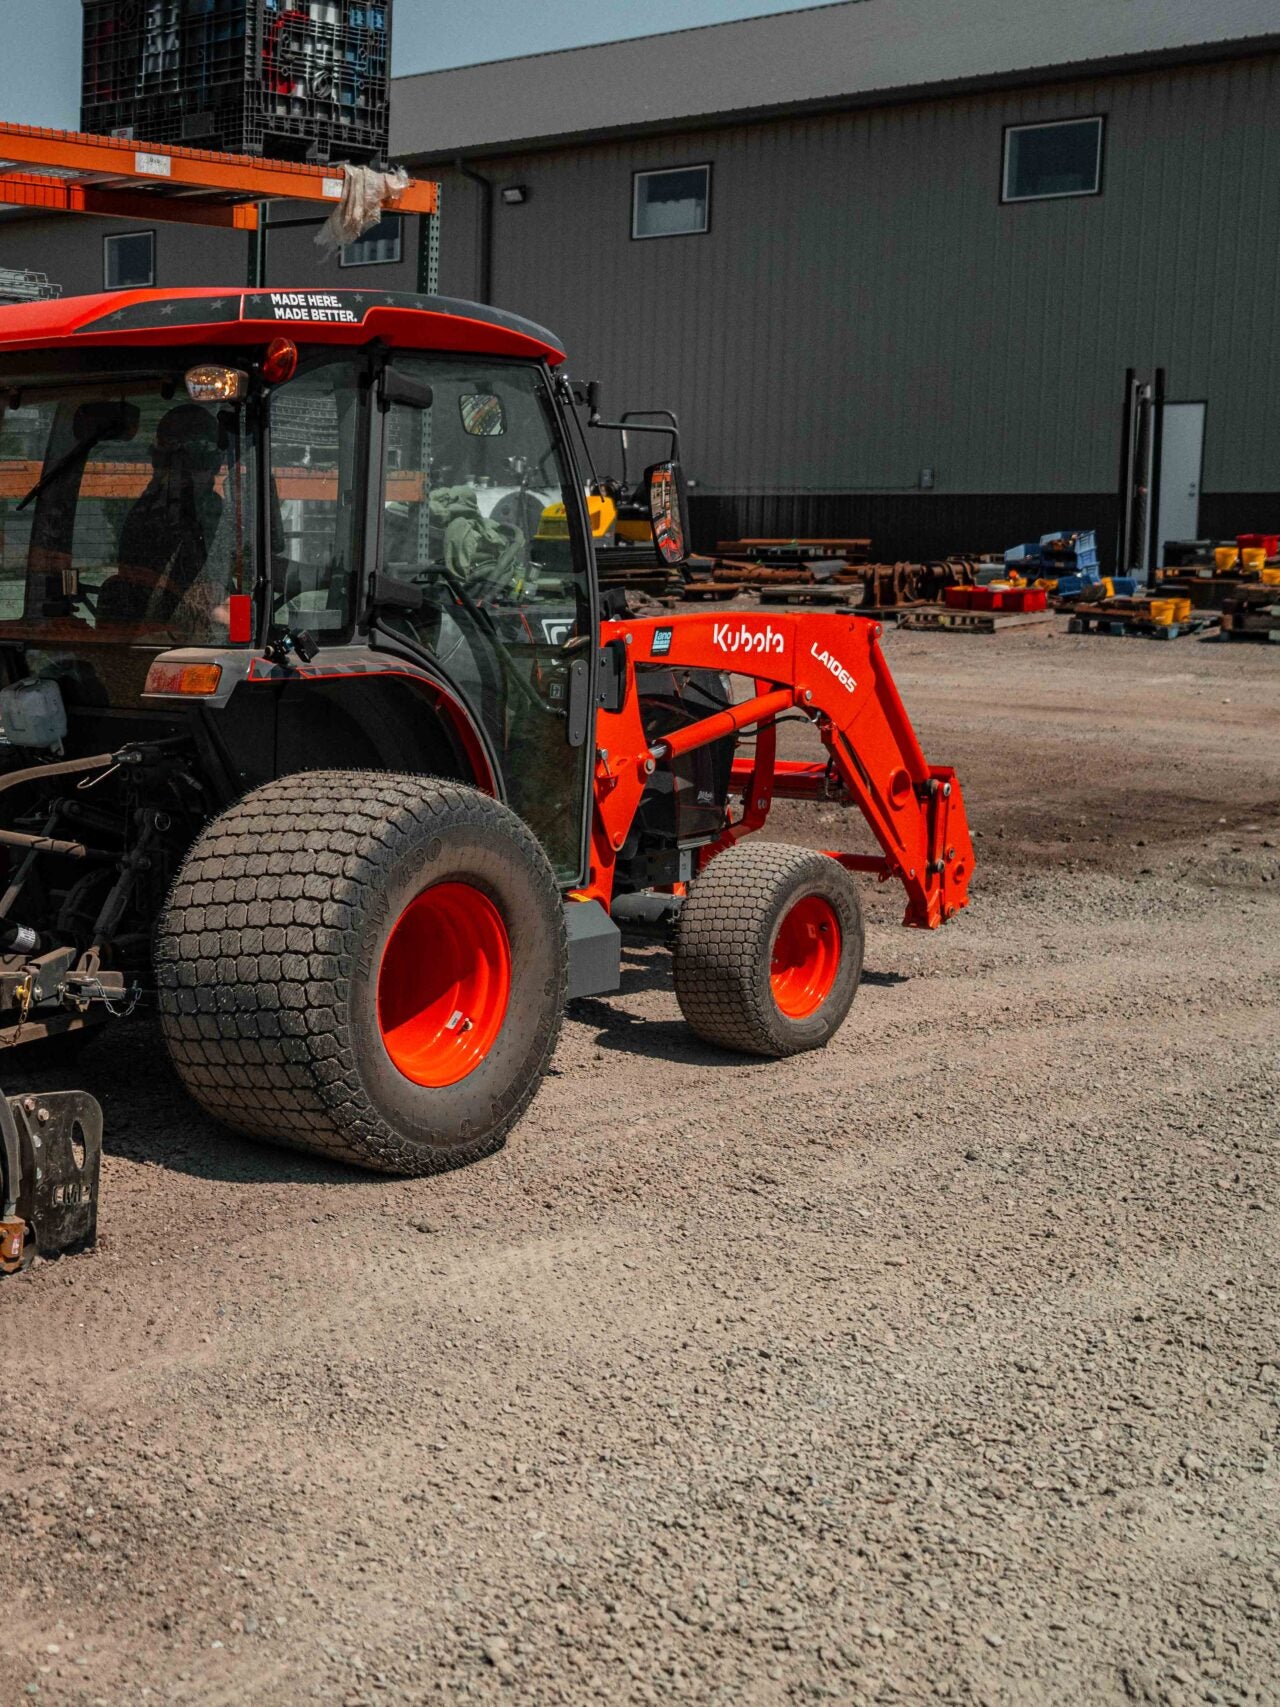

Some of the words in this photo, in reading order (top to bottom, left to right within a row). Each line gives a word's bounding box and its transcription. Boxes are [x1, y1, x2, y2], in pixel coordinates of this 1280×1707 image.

[270, 293, 307, 306] MADE
[307, 294, 342, 308] HERE.
[274, 307, 310, 320] MADE
[310, 308, 358, 323] BETTER.
[713, 623, 785, 653] Kubota
[810, 641, 858, 693] LA1065
